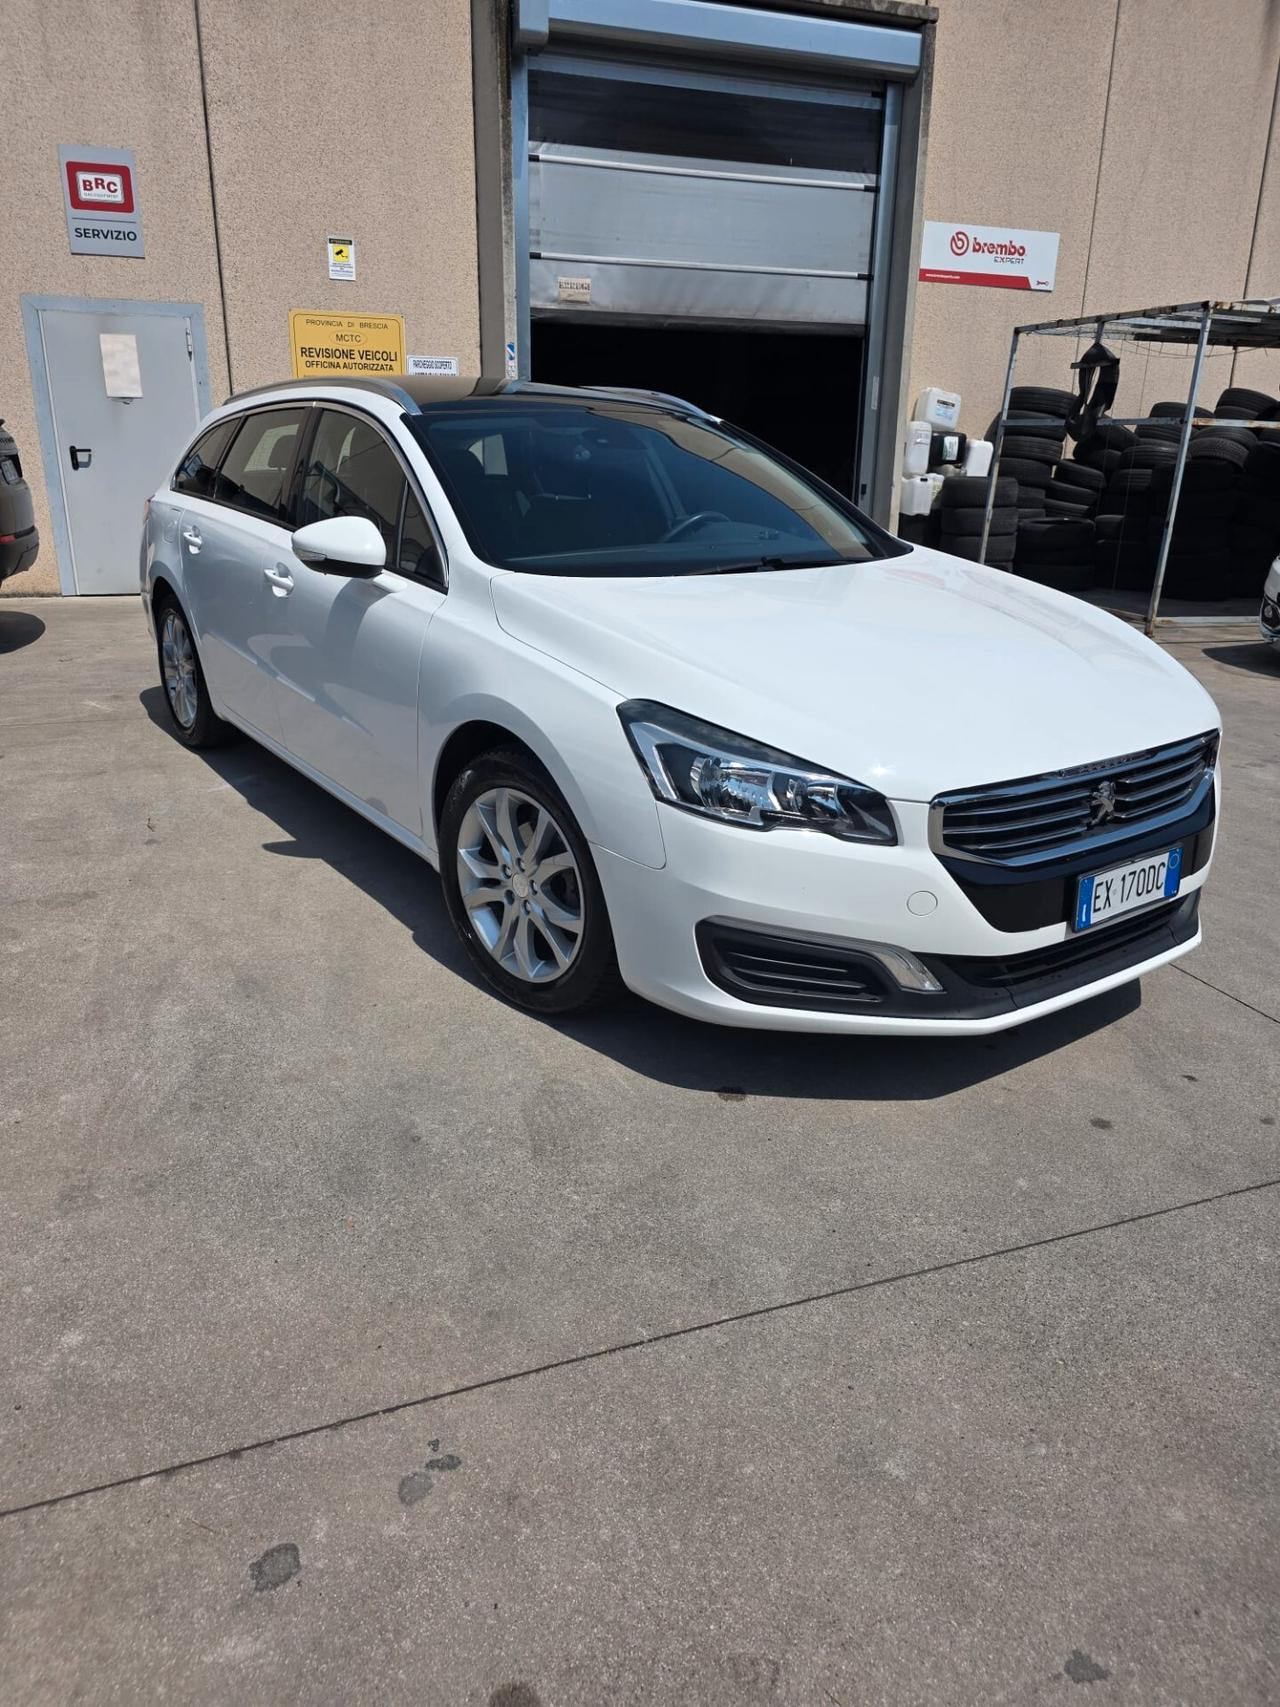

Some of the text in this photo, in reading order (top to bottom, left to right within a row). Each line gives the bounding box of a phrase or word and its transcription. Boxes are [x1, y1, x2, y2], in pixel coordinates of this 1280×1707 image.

[82, 177, 118, 194] BRC
[74, 227, 137, 241] SERVIZIO
[972, 237, 1026, 256] brembo
[993, 256, 1025, 265] EXPERT
[305, 319, 343, 327] PROVINCIA
[360, 322, 389, 330] BRESCIA
[335, 333, 361, 343] MCTC
[300, 346, 398, 362] REVISIONE VEICOLI
[305, 360, 394, 372] OFFICINA AUTORIZZATA
[1092, 861, 1166, 914] EX 170DC
